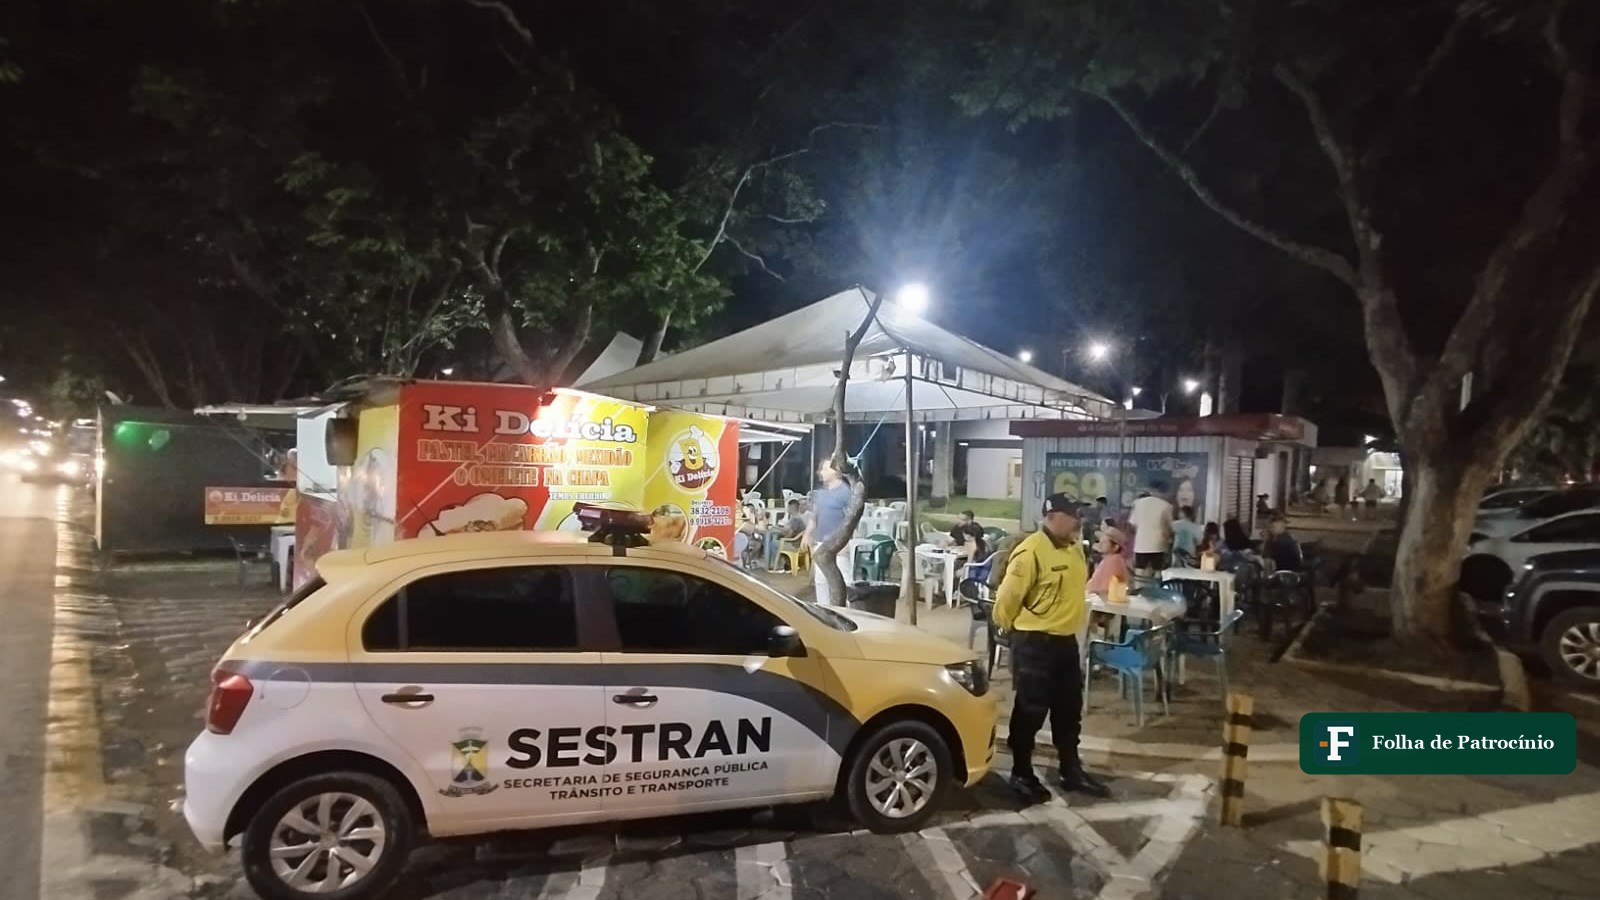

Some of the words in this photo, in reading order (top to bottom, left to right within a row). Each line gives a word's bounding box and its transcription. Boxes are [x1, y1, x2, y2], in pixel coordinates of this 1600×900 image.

[423, 404, 479, 433] Ki
[494, 410, 637, 443] Delícia
[575, 447, 633, 467] MEXIDÃO
[1050, 459, 1100, 468] INTERNET
[544, 469, 563, 486] NA
[568, 470, 609, 486] CHAPA
[224, 492, 238, 502] Ki
[1053, 472, 1107, 508] 69
[505, 717, 772, 769] SESTRAN
[503, 775, 597, 789] SECRETARIA
[602, 773, 621, 783] DE
[625, 766, 710, 781] SEGURANÇA
[714, 761, 768, 774] PÚBLICA
[549, 787, 623, 800] TRÂNSITO
[627, 785, 636, 795] E
[640, 777, 729, 793] TRANSPORTE
